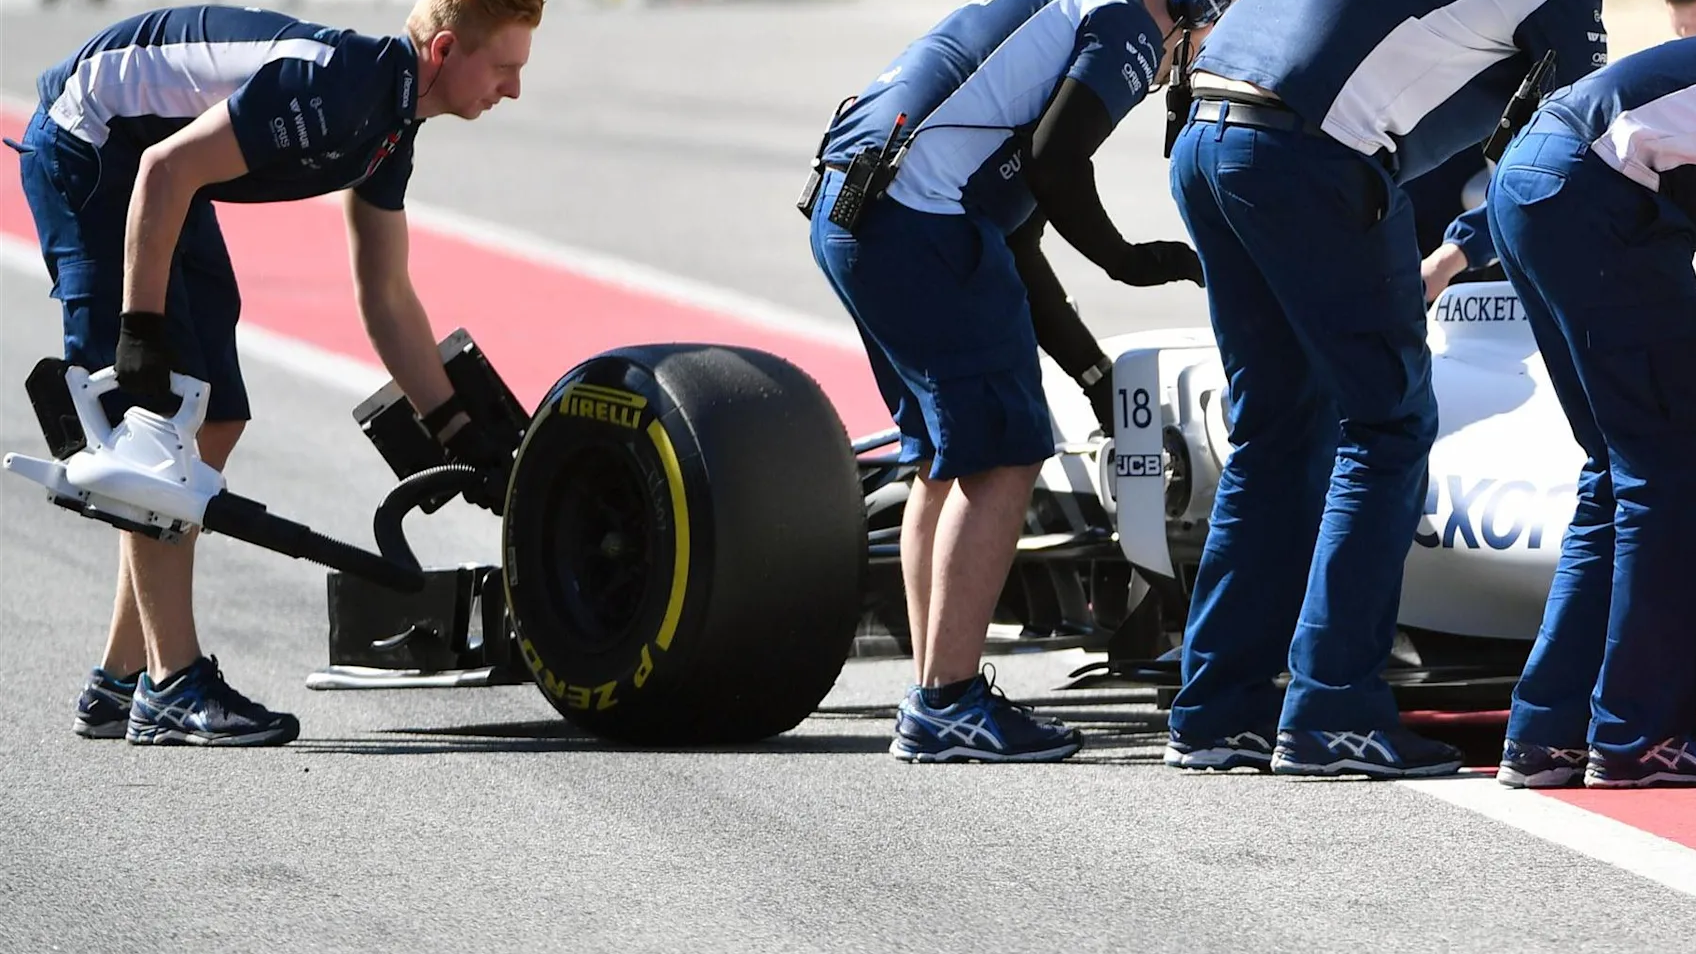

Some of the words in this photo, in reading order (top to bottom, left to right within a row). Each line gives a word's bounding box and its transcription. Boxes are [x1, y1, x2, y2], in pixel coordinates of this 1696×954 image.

[1435, 294, 1528, 322] HACKET
[559, 381, 648, 430] PIRELLI
[1118, 388, 1153, 429] 18
[1117, 454, 1162, 477] JCB
[523, 637, 619, 711] ZERO
[633, 642, 654, 689] P
